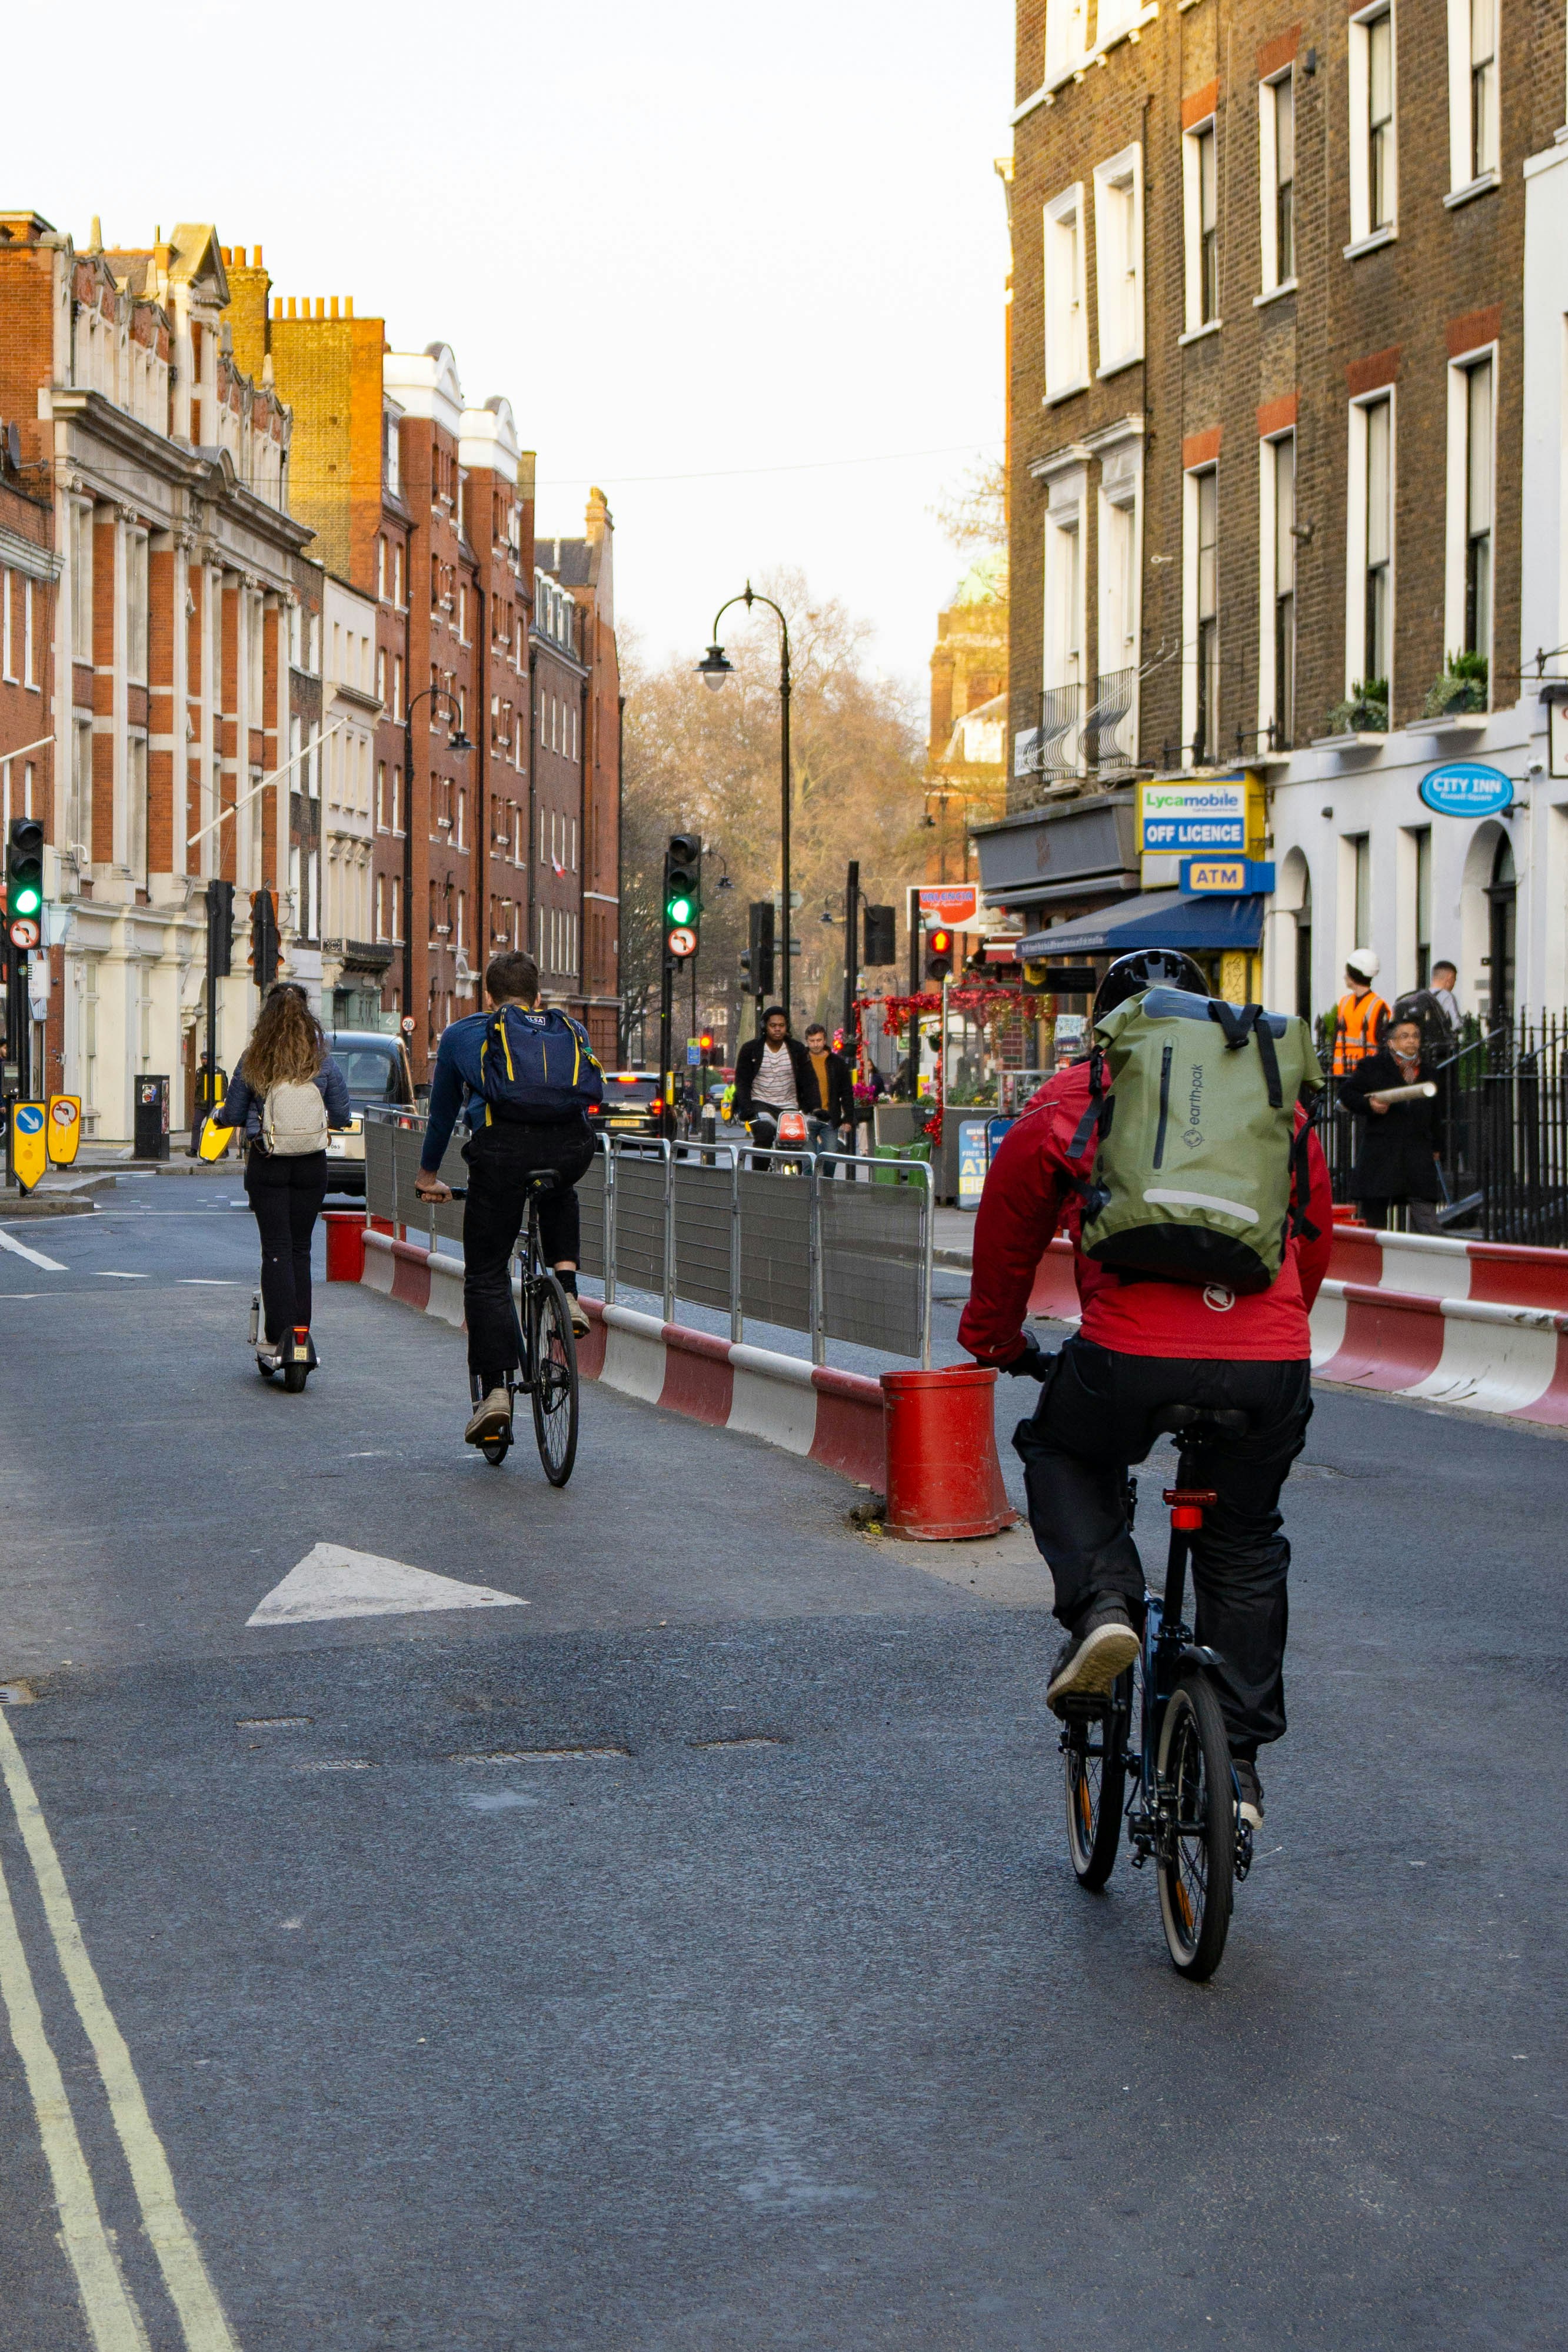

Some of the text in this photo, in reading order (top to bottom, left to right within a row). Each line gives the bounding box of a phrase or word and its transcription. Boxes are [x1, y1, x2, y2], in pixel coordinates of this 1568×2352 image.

[1433, 777, 1502, 794] CITY INN
[1146, 792, 1239, 809] Lycamobile
[1147, 825, 1241, 842] OFF LICENCE
[1196, 869, 1237, 884] ATM
[920, 891, 973, 901] VALENCIA
[961, 1158, 992, 1175] AT
